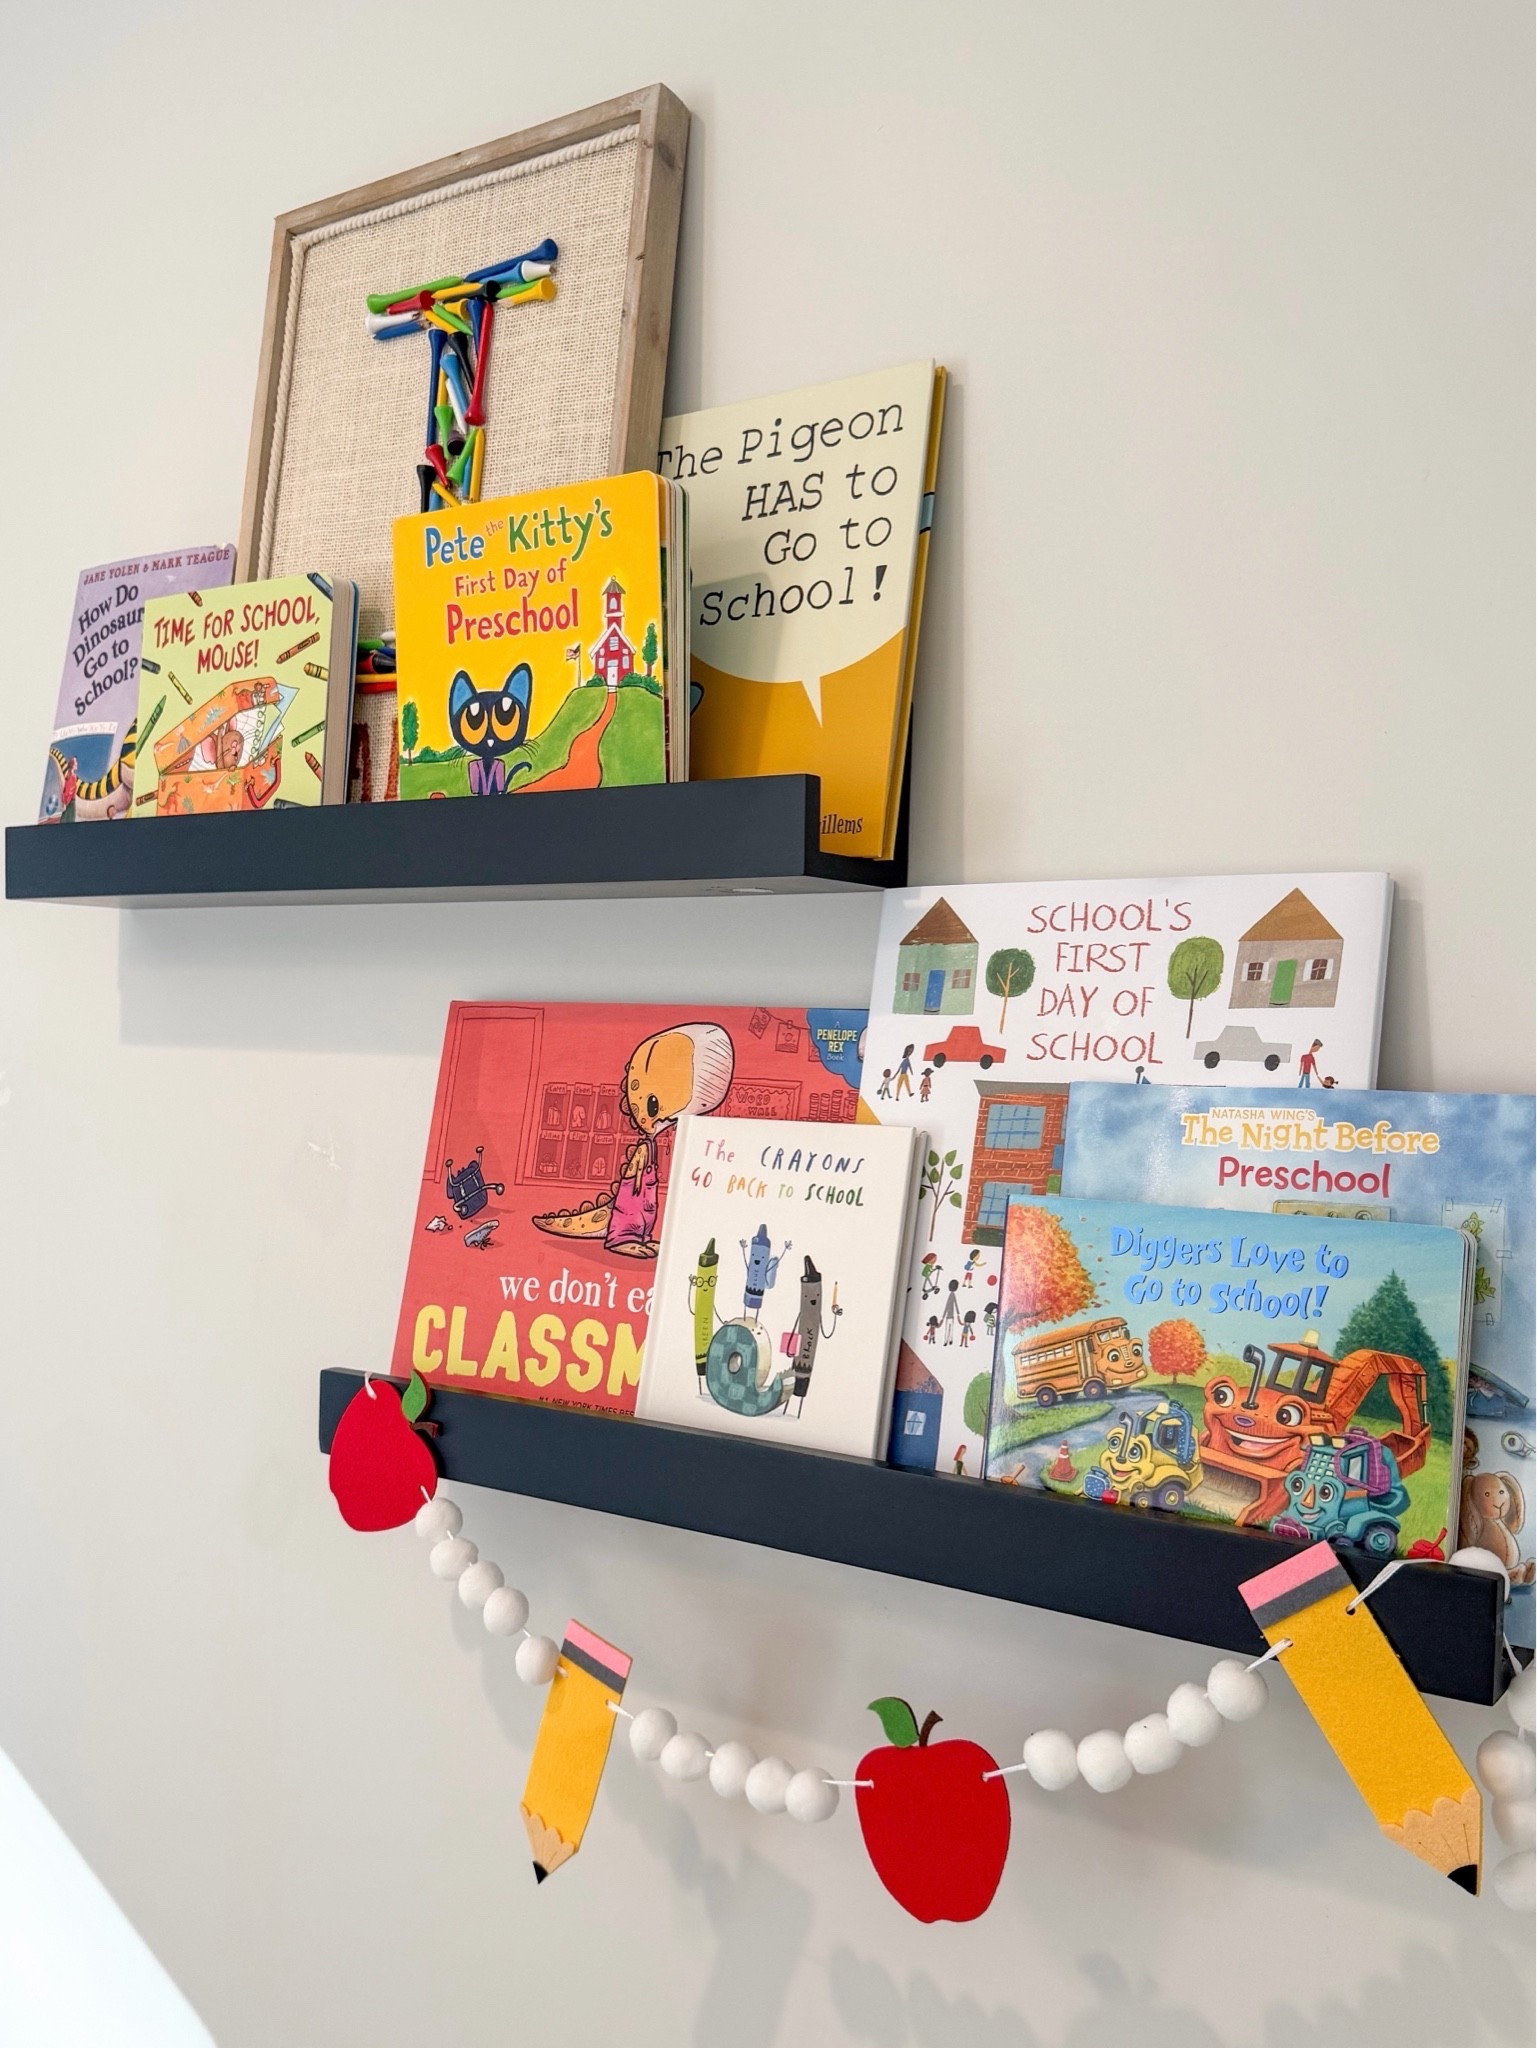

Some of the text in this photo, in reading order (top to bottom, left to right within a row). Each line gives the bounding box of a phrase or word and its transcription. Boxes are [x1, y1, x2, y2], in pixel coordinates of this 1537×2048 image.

[657, 404, 903, 480] The Pigeon
[741, 464, 898, 521] HAS to
[425, 498, 613, 568] Pete the Kitty's
[764, 517, 892, 565] Go to
[83, 549, 231, 586] JANE YOLEN & MARK TEAGUE
[455, 557, 568, 598] First Day of
[78, 584, 139, 635] How Do
[154, 594, 321, 649] TIME FOR SCHOOL,
[446, 588, 579, 645] Preschool
[83, 638, 130, 679] Go to
[197, 639, 259, 675] MOUSE!
[74, 657, 139, 717] School?
[820, 813, 863, 835] illems
[1026, 898, 1194, 934] SCHOOL'S
[1056, 942, 1151, 974] FIRST
[1036, 983, 1156, 1018] DAY OF
[816, 1029, 858, 1042] PENELOPE
[828, 1041, 845, 1053] REX
[1025, 1031, 1164, 1065] SCHOOL
[1181, 1113, 1440, 1155] The Night Before
[1211, 1108, 1316, 1122] NATASHA WING'S
[704, 1139, 865, 1174] The CRAYONS
[691, 1167, 864, 1207] GO BACK TO SCHOOL
[1217, 1156, 1391, 1198] Preschool
[1110, 1226, 1350, 1279] Diggers Love to
[500, 1276, 540, 1302] we
[549, 1267, 618, 1308] don't
[1123, 1274, 1164, 1305] Go
[1170, 1277, 1203, 1307] to
[552, 1398, 570, 1407] NEW
[572, 1400, 593, 1410] YORK
[595, 1404, 617, 1414] TIMES
